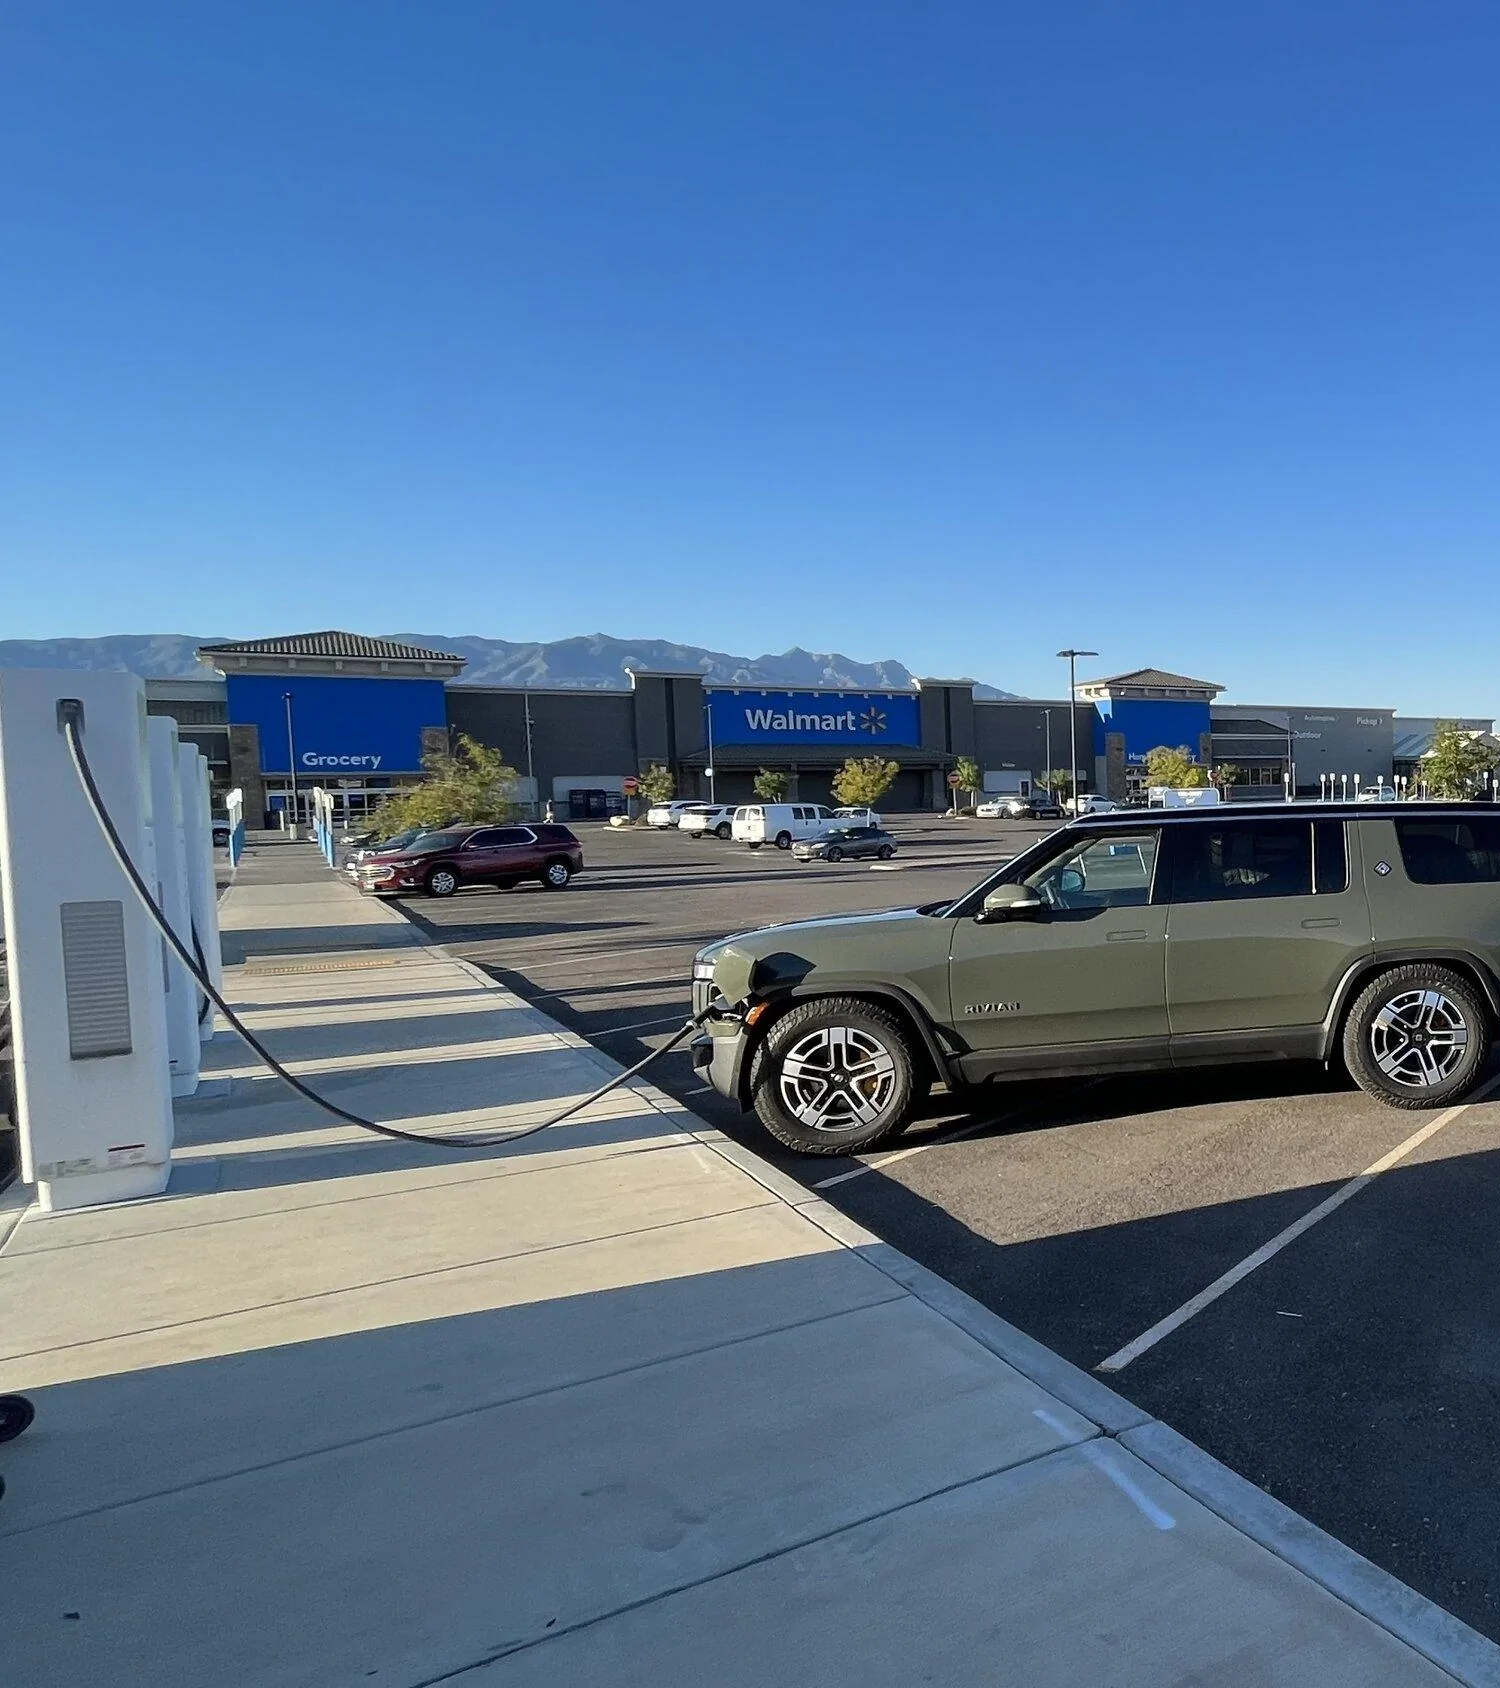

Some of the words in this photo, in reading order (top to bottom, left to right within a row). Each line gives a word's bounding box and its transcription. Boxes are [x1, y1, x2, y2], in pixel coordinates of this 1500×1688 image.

[745, 709, 856, 731] Walmart
[1356, 716, 1378, 727] Pickup
[302, 752, 382, 770] Grocery
[964, 1002, 1021, 1014] RIVIAN
